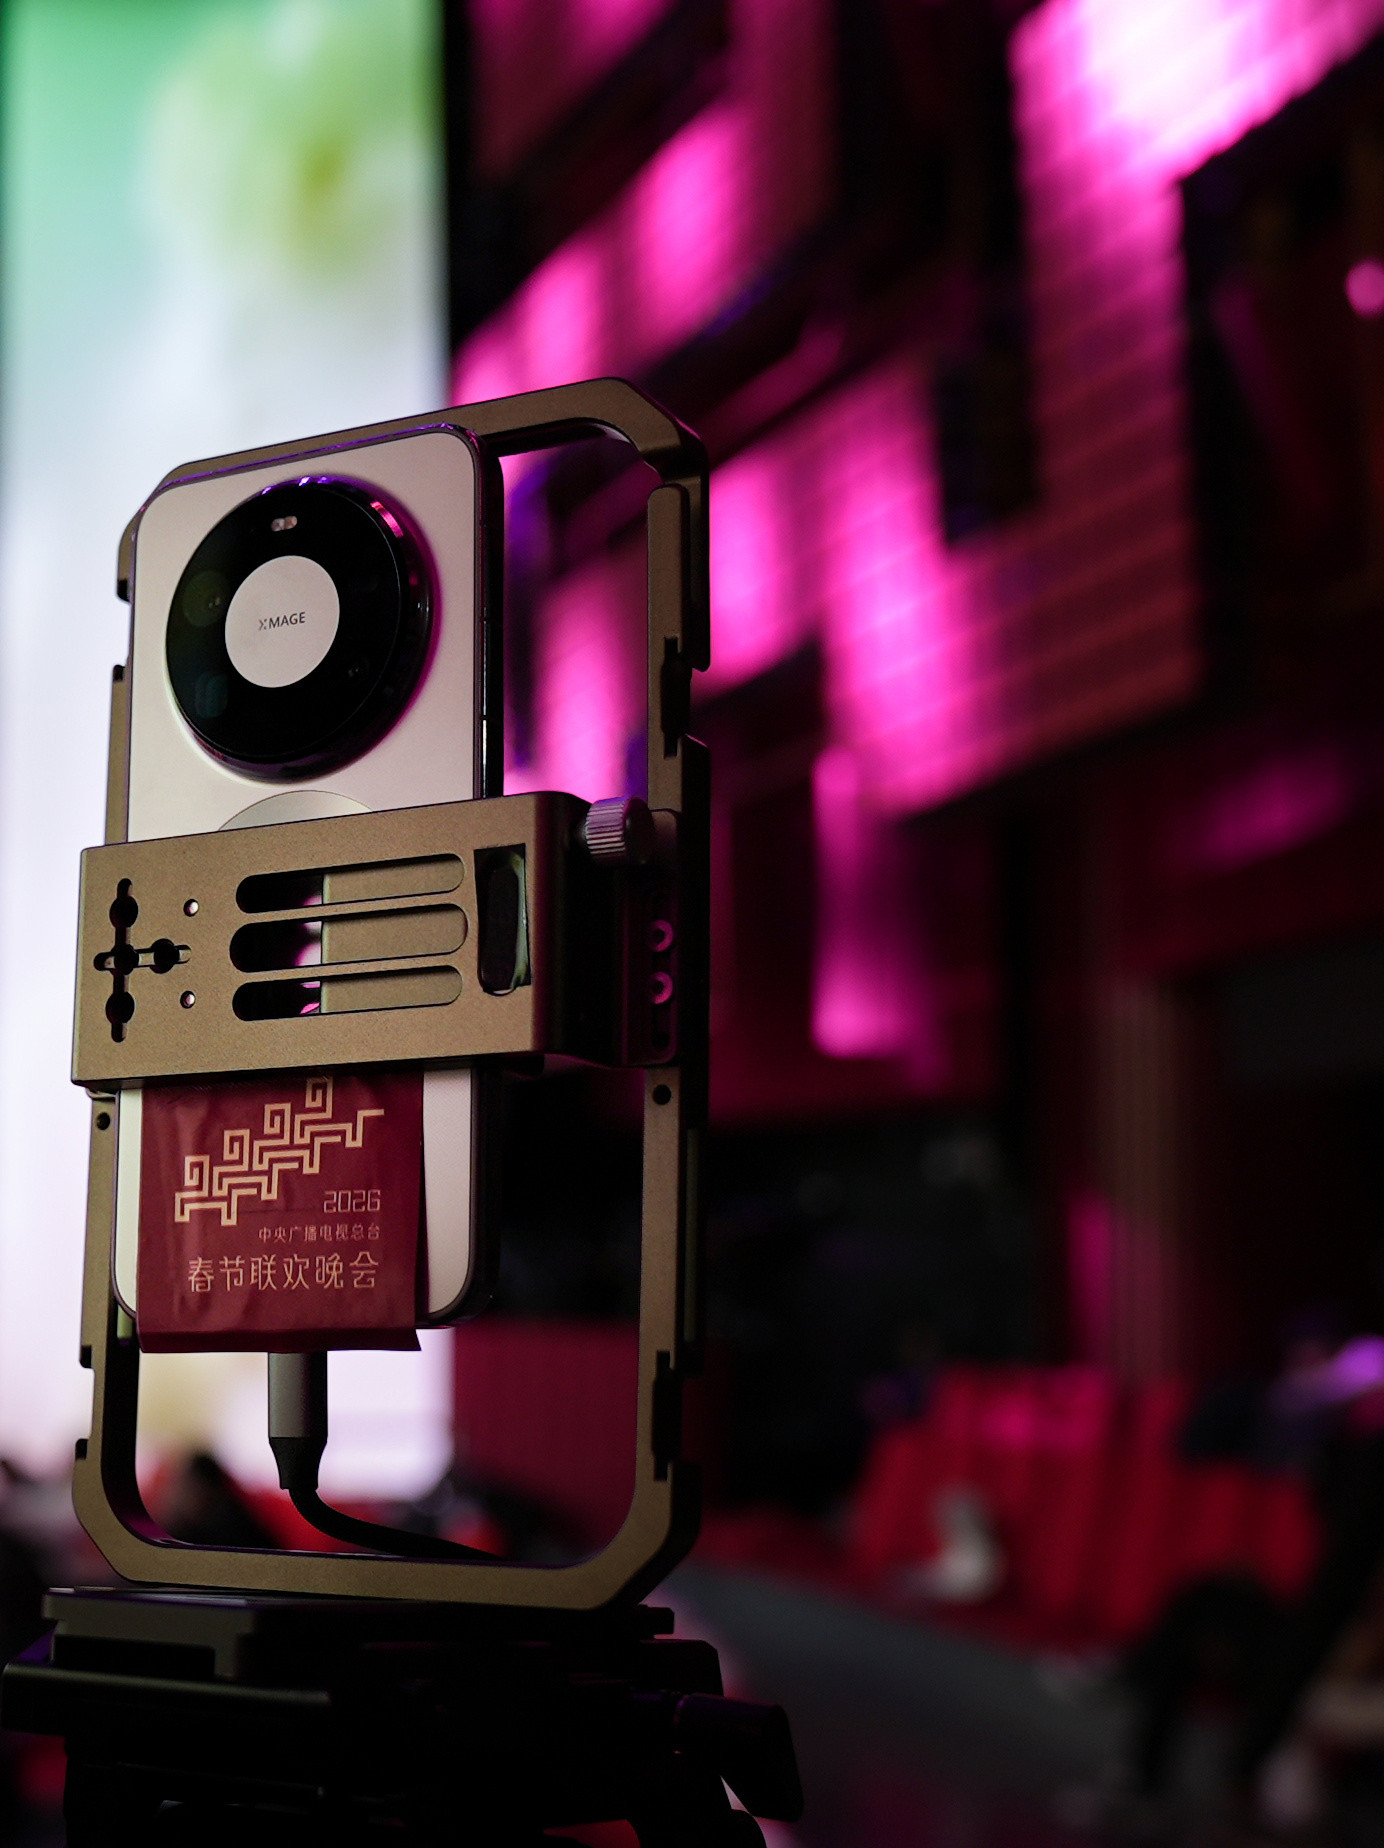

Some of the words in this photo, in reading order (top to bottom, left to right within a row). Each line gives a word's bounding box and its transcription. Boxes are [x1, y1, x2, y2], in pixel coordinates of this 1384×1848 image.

[258, 612, 306, 631] XMAGE
[323, 1189, 381, 1213] 2026
[259, 1222, 380, 1243] 中央广播电视总台
[188, 1251, 379, 1293] 春节联欢晚会
